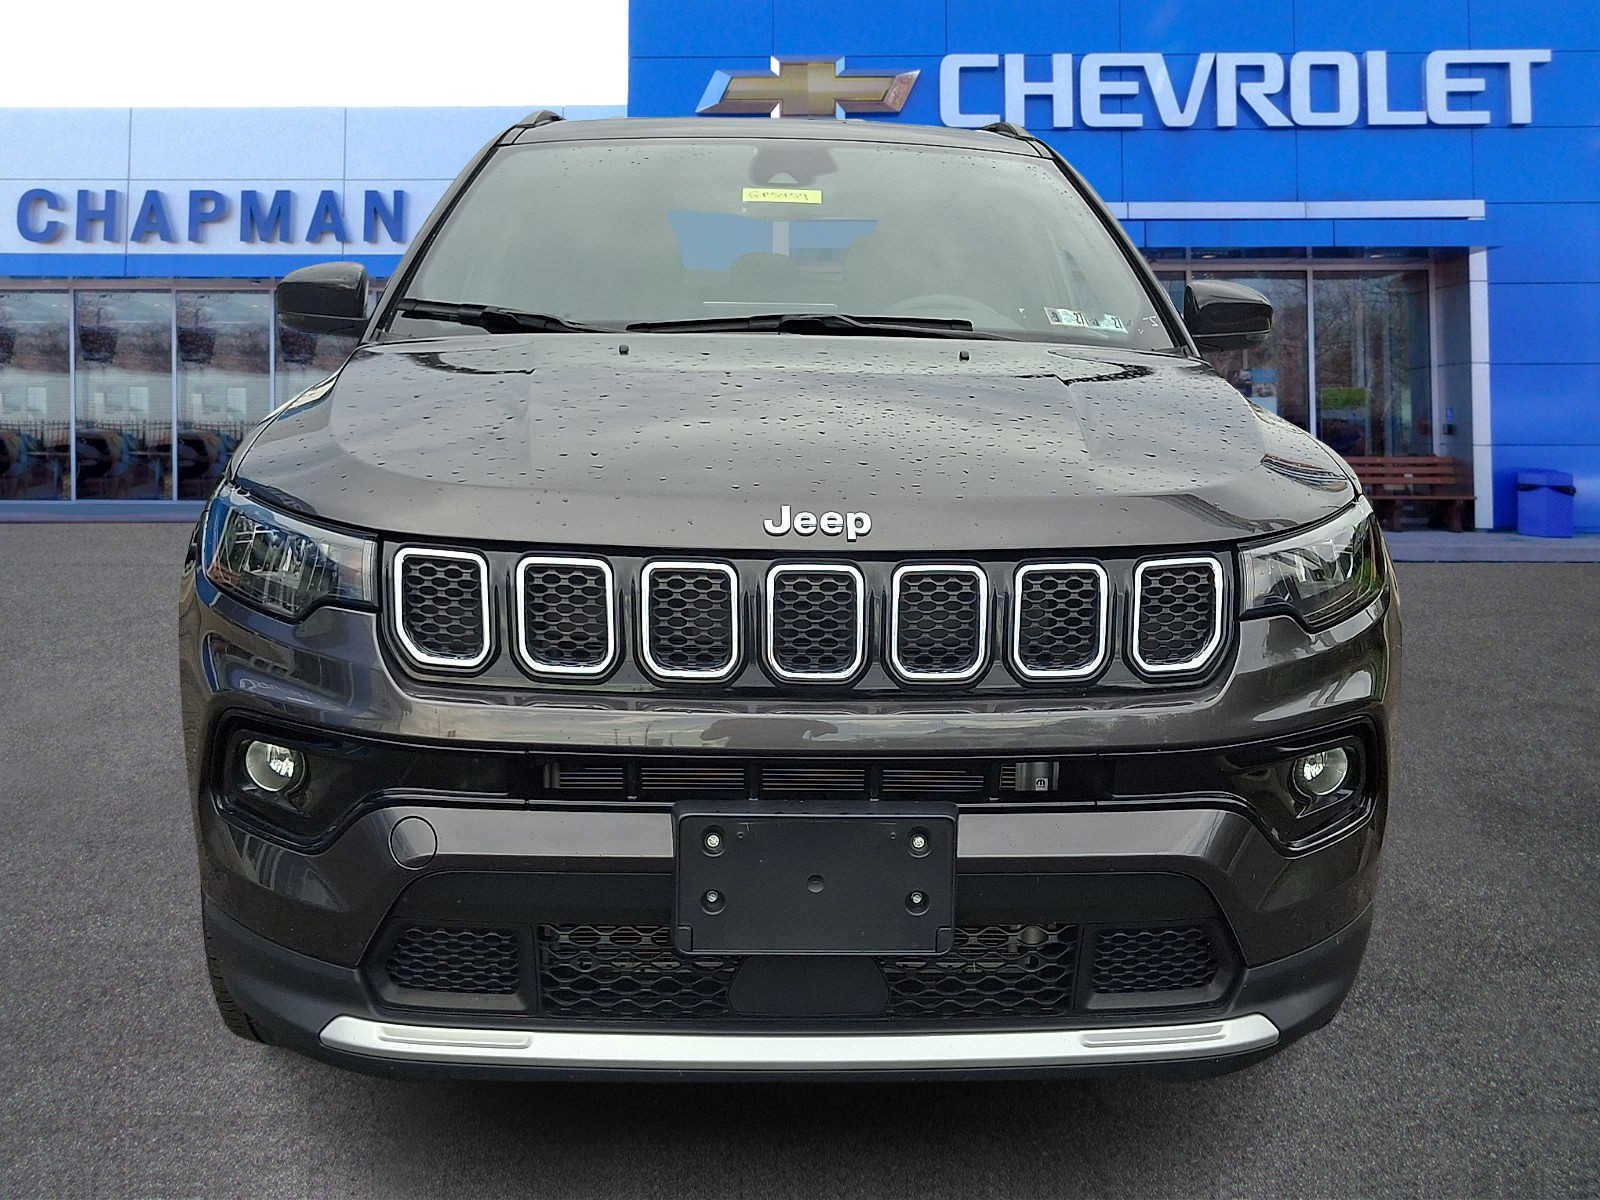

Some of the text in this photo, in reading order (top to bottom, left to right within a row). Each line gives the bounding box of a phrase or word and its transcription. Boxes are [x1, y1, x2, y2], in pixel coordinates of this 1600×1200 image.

[940, 49, 1551, 128] CHEVROLET
[16, 188, 407, 244] CHAPMAN
[763, 504, 872, 542] Jeep
